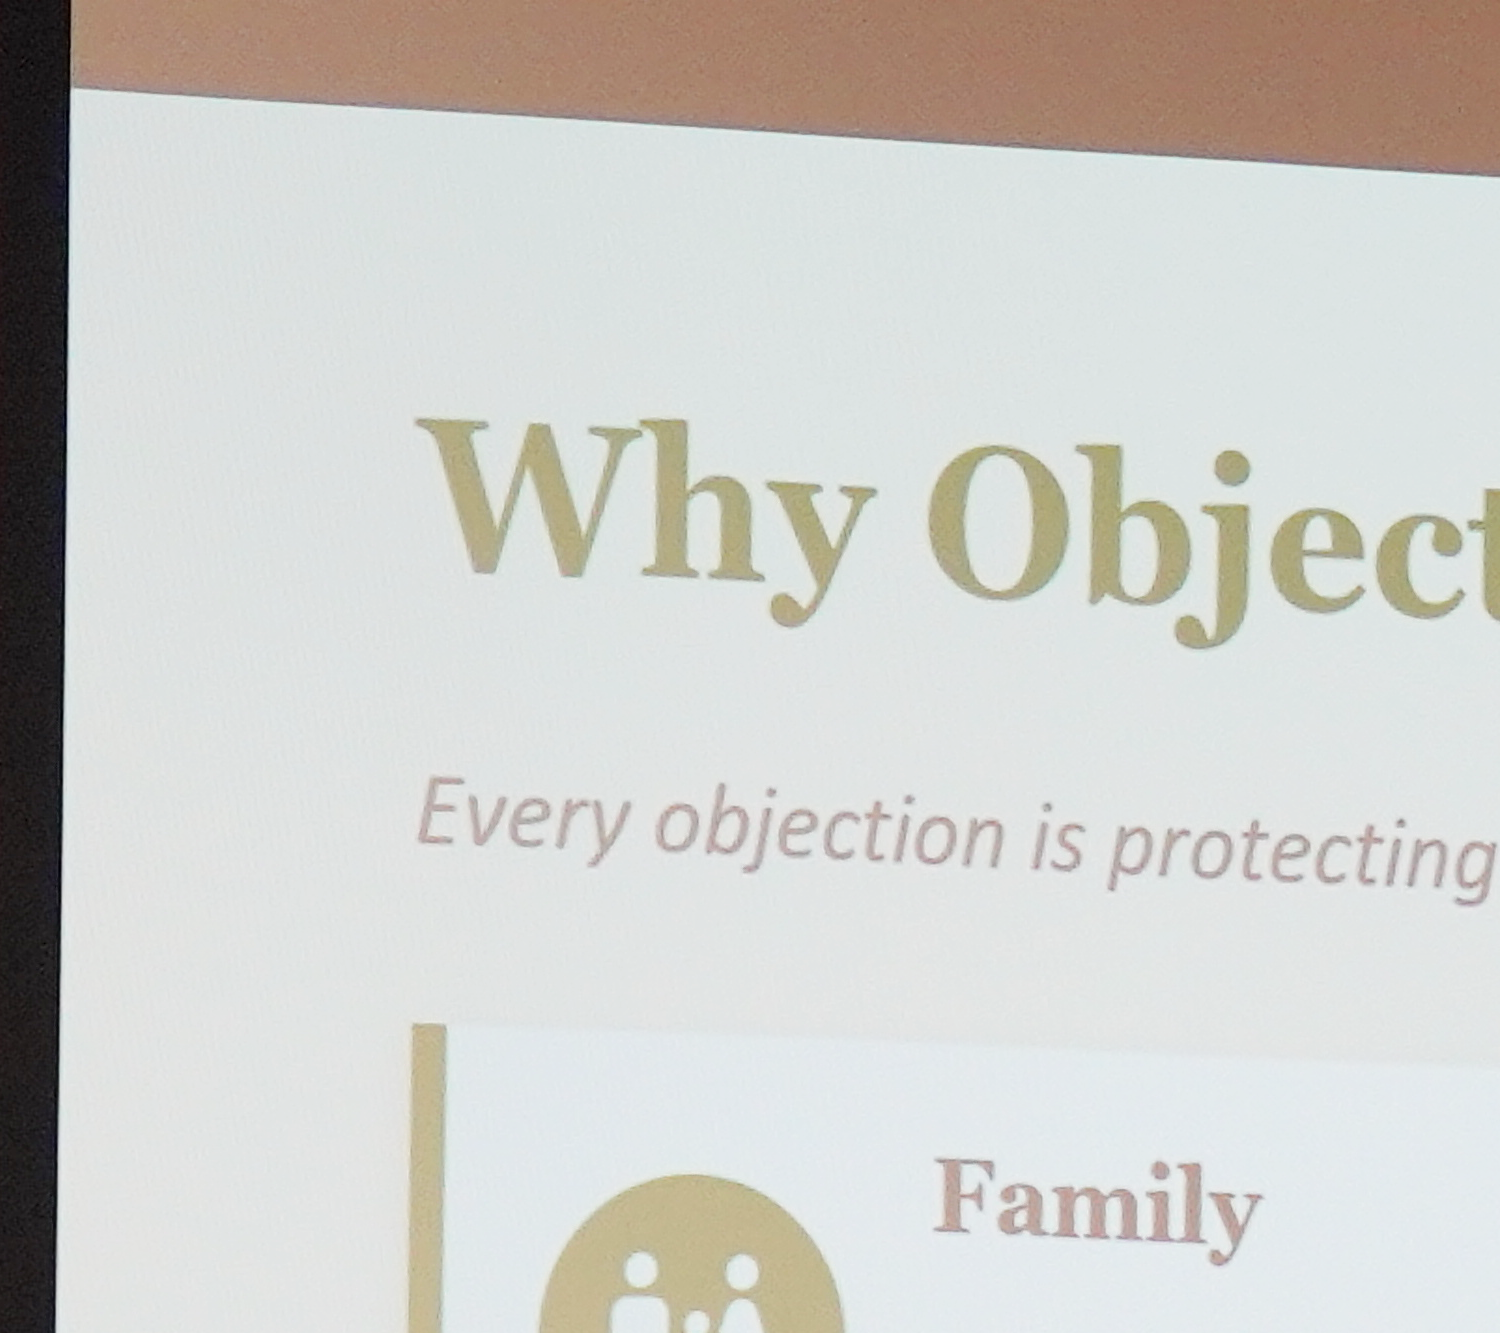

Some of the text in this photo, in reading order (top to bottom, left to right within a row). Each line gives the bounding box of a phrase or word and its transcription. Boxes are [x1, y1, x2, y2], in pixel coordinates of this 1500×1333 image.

[415, 416, 879, 629] Why
[417, 775, 632, 868] Every
[655, 782, 1005, 876] objection
[1031, 801, 1087, 873] is
[1106, 817, 1498, 908] protecting
[932, 1156, 1265, 1268] Family
